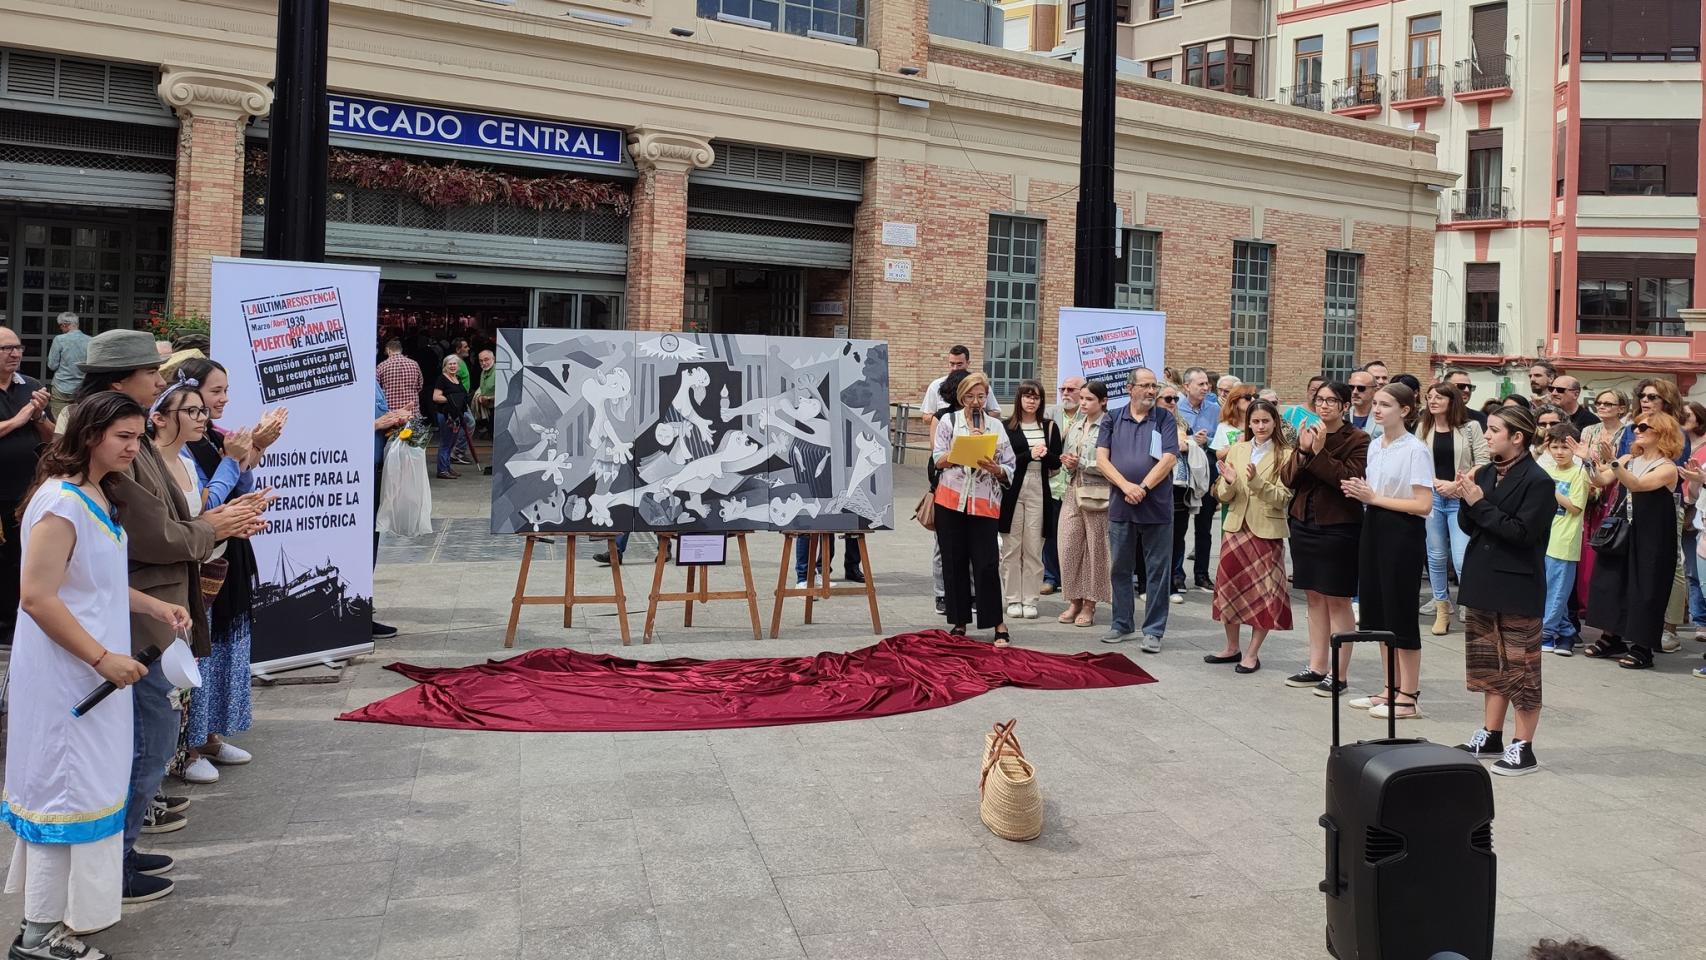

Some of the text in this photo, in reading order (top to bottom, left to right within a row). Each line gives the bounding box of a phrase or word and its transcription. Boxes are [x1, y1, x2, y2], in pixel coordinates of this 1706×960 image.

[328, 100, 605, 156] ERCADO CENTRAL
[286, 315, 306, 329] 1939
[289, 318, 344, 338] BOCANA DEL
[253, 333, 292, 353] PUERTO
[291, 328, 346, 349] DE ALICANTE
[263, 351, 347, 375] comisión cívica para
[1082, 356, 1108, 370] PUERTO
[1107, 354, 1143, 368] DE ALICANTE
[276, 360, 349, 384] la recuperación de
[267, 373, 349, 397] la memoria histórica
[258, 447, 348, 468] OMISIÓN CÍVICA
[255, 470, 360, 491] ALICANTE PARA LA
[262, 491, 360, 512] PERACIÓN DE LA
[255, 512, 356, 535] ORIA HISTÓRICA
